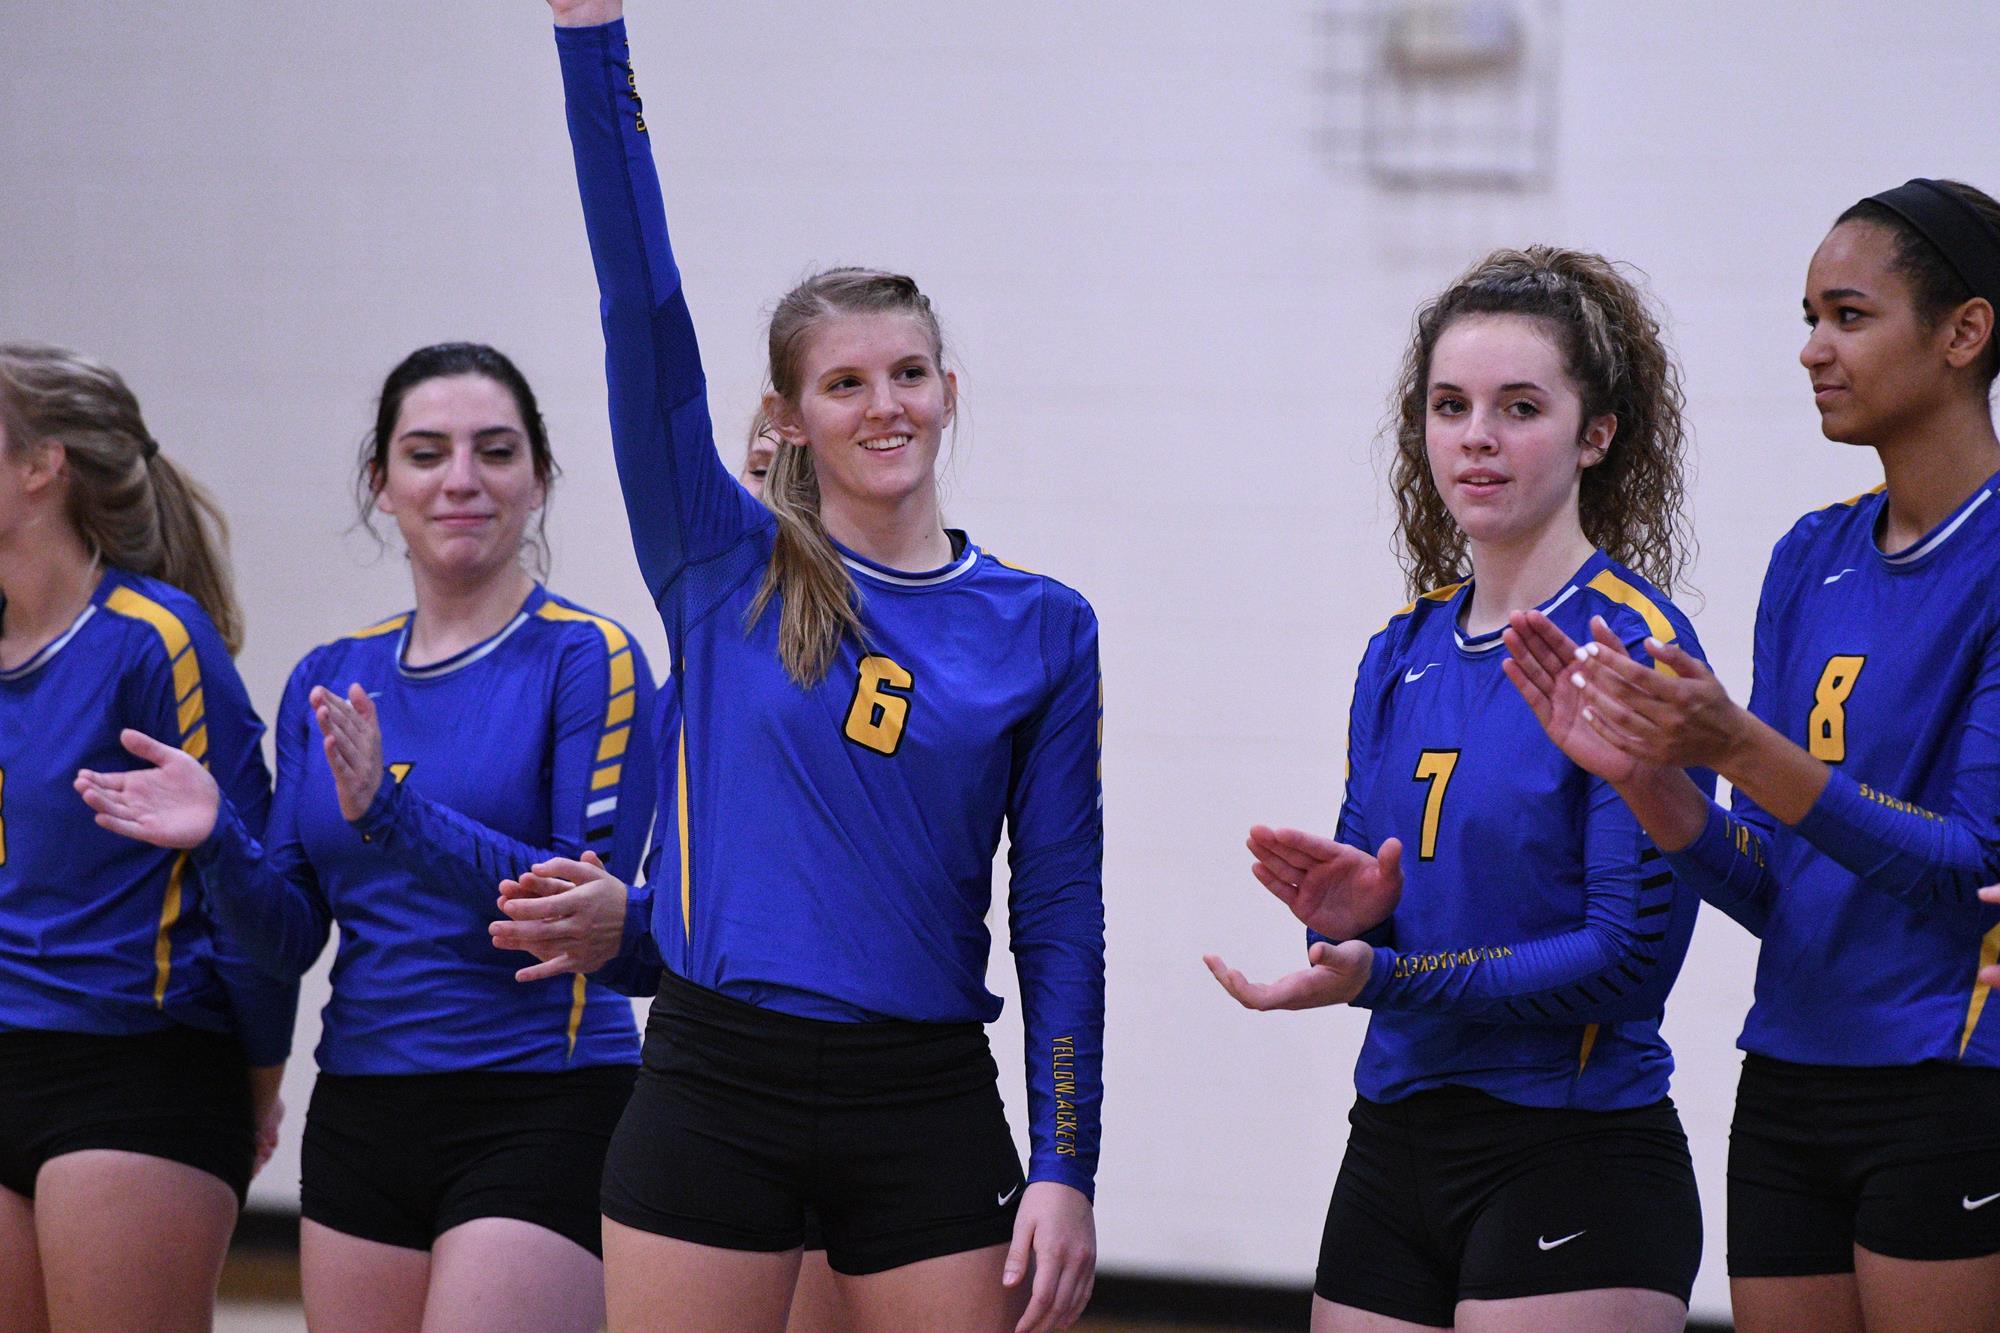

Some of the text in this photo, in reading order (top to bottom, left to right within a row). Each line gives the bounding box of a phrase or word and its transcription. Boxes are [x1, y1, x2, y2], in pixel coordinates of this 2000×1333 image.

[841, 651, 915, 757] 6
[1807, 653, 1867, 765] 8
[1412, 748, 1461, 861] 7
